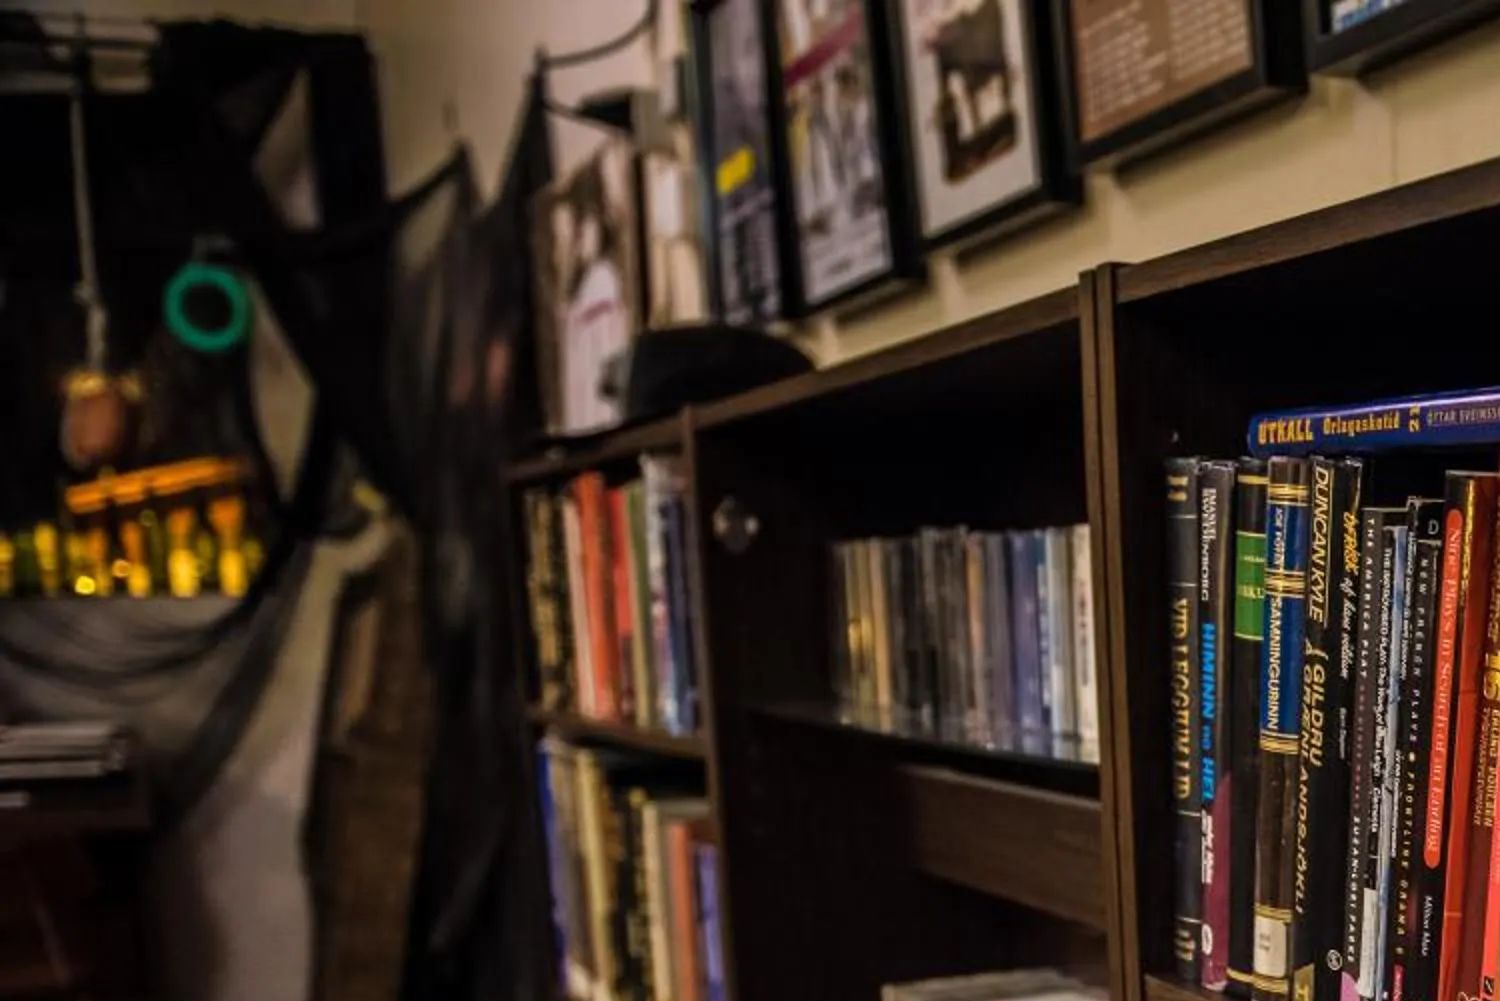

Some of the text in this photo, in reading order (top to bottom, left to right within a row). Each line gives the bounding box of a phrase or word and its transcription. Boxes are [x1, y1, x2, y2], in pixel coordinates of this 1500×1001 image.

[1309, 464, 1329, 624] DUNCAN KYLE
[1365, 518, 1376, 548] THE
[1362, 556, 1374, 631] AMERICA
[1443, 578, 1458, 632] Plays
[1201, 623, 1217, 719] HIMINN
[1268, 599, 1283, 730] SAMNINGURINN
[1359, 639, 1370, 680] PLAY
[1409, 559, 1429, 742] NEW FRENCH PLAYS
[1309, 664, 1326, 767] GILDRU
